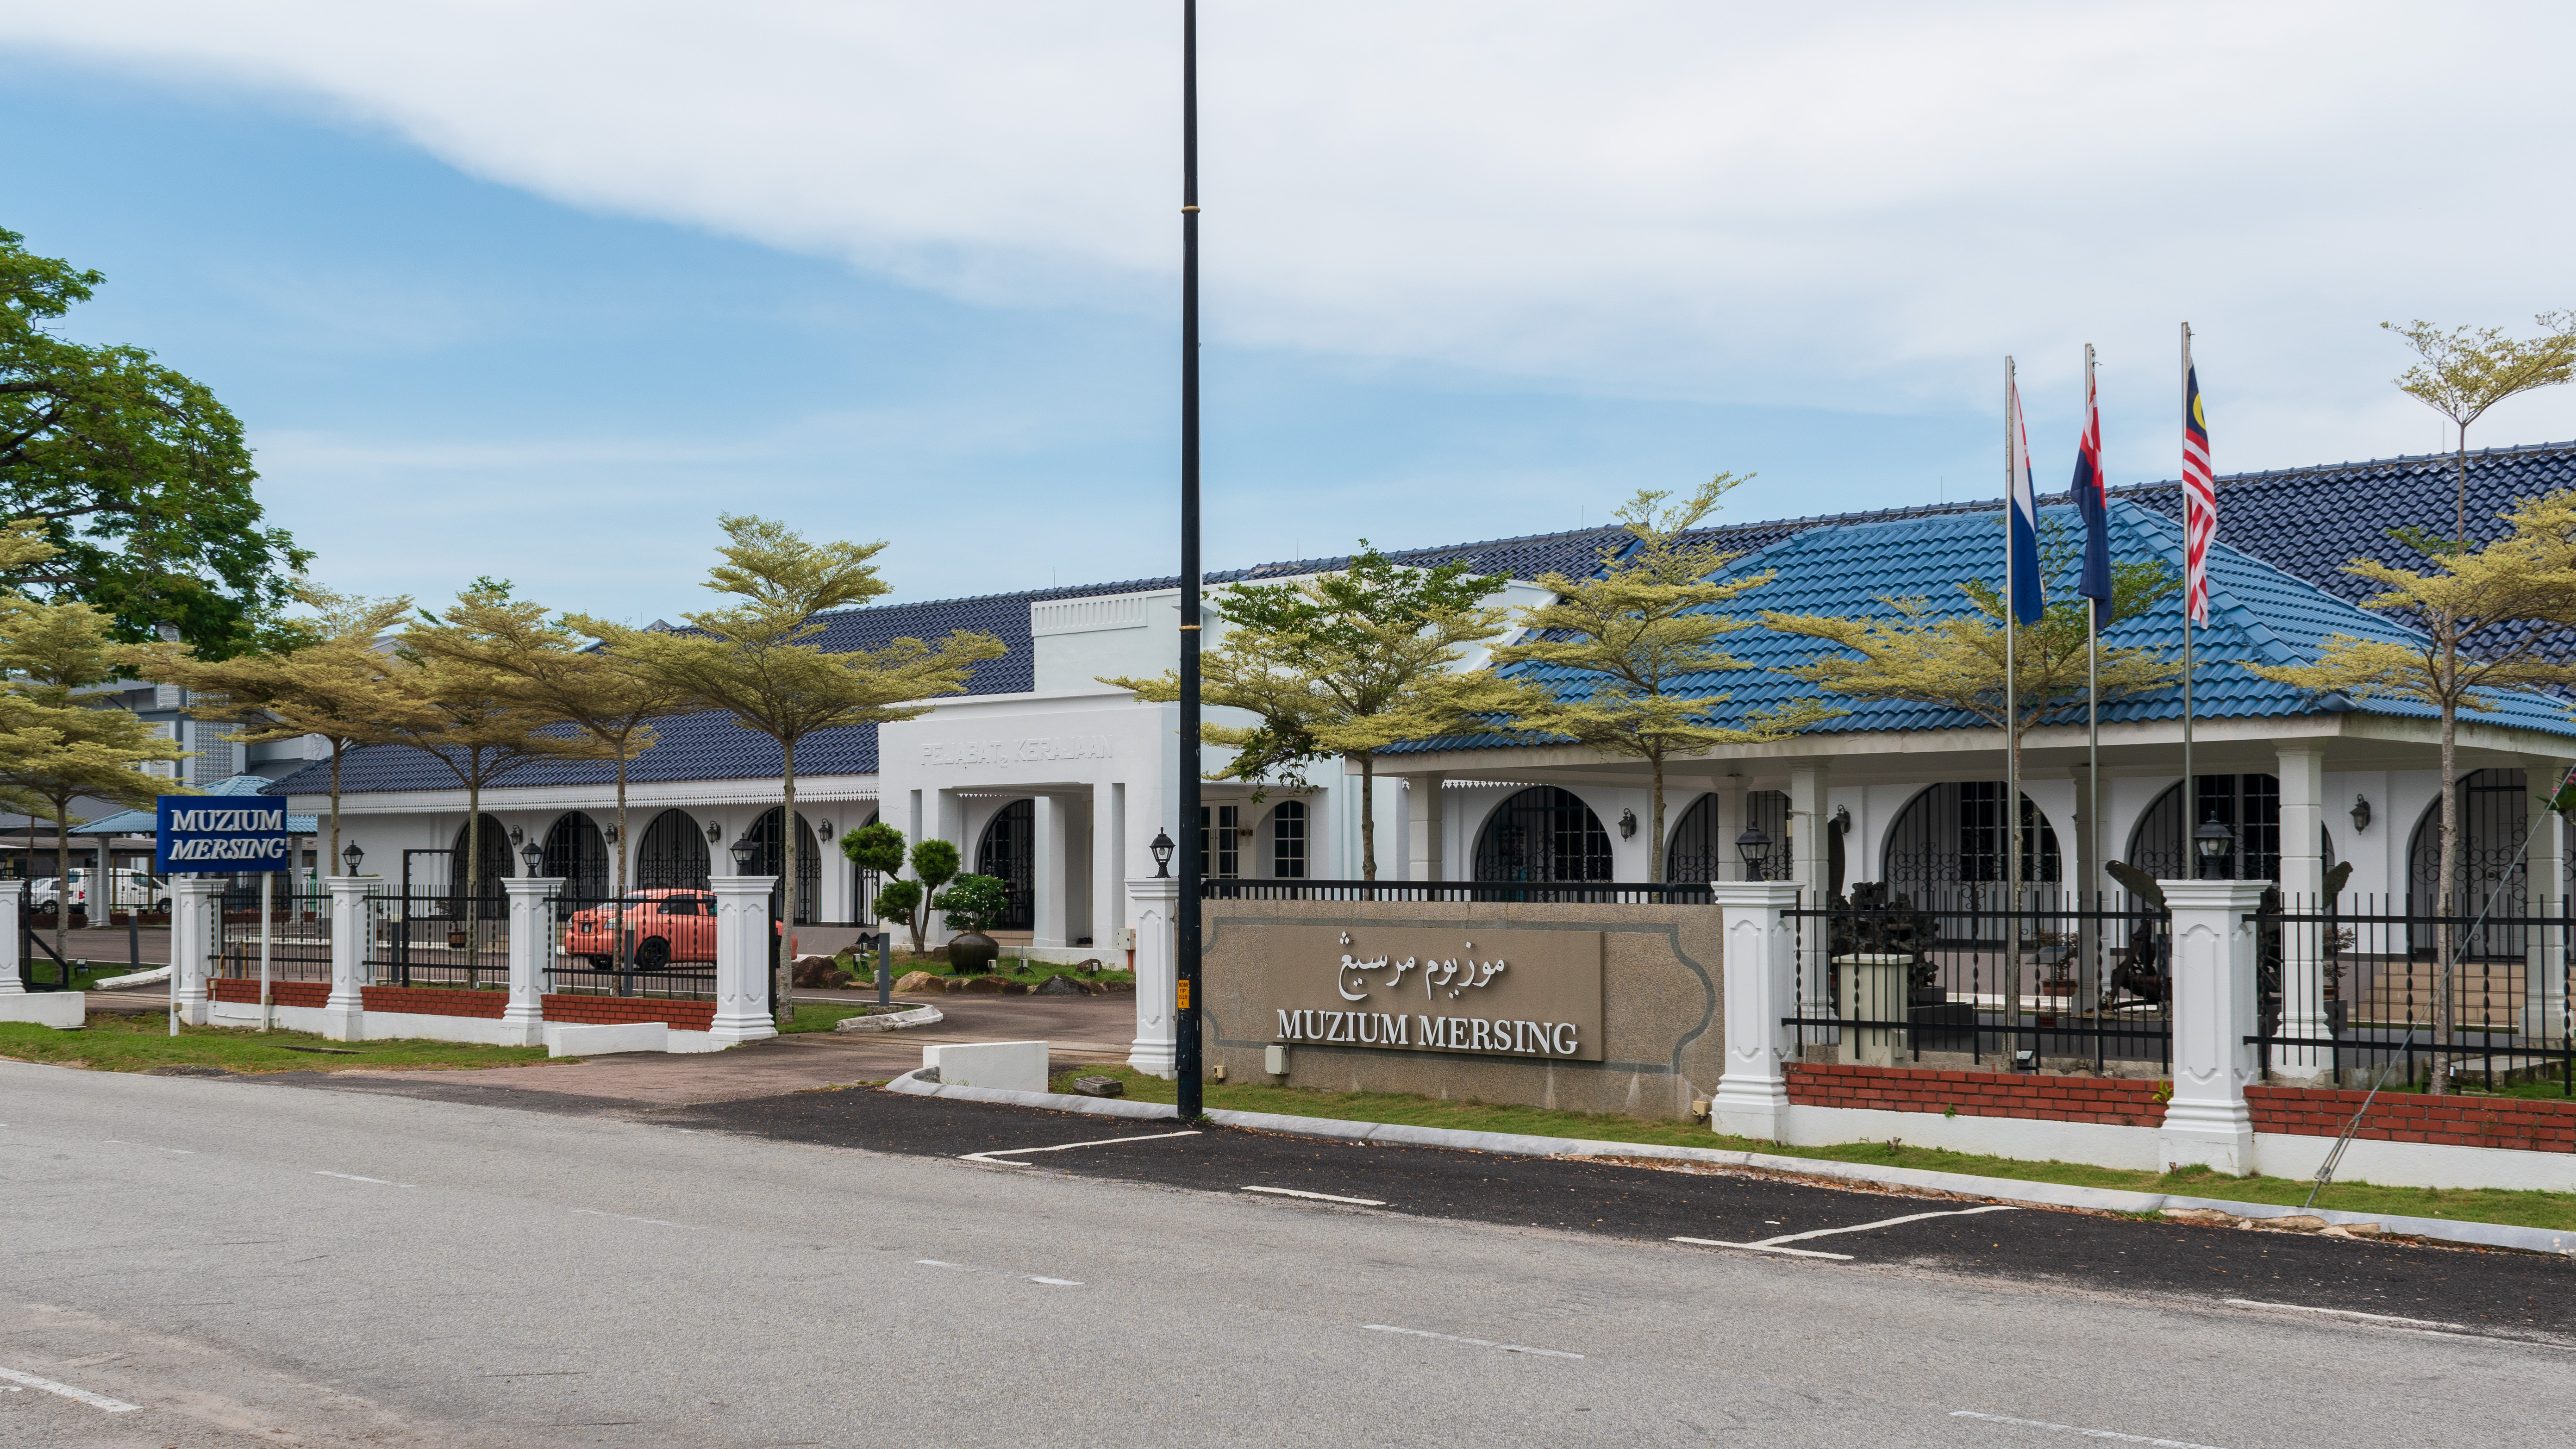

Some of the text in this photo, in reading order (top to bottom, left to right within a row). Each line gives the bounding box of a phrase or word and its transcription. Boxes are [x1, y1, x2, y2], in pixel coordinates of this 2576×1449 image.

[1014, 735, 1113, 762] KERAJAAN
[170, 809, 283, 831] MUZIUM
[168, 837, 285, 861] MERSING
[1276, 1009, 1578, 1055] MUZIUM MERSING
